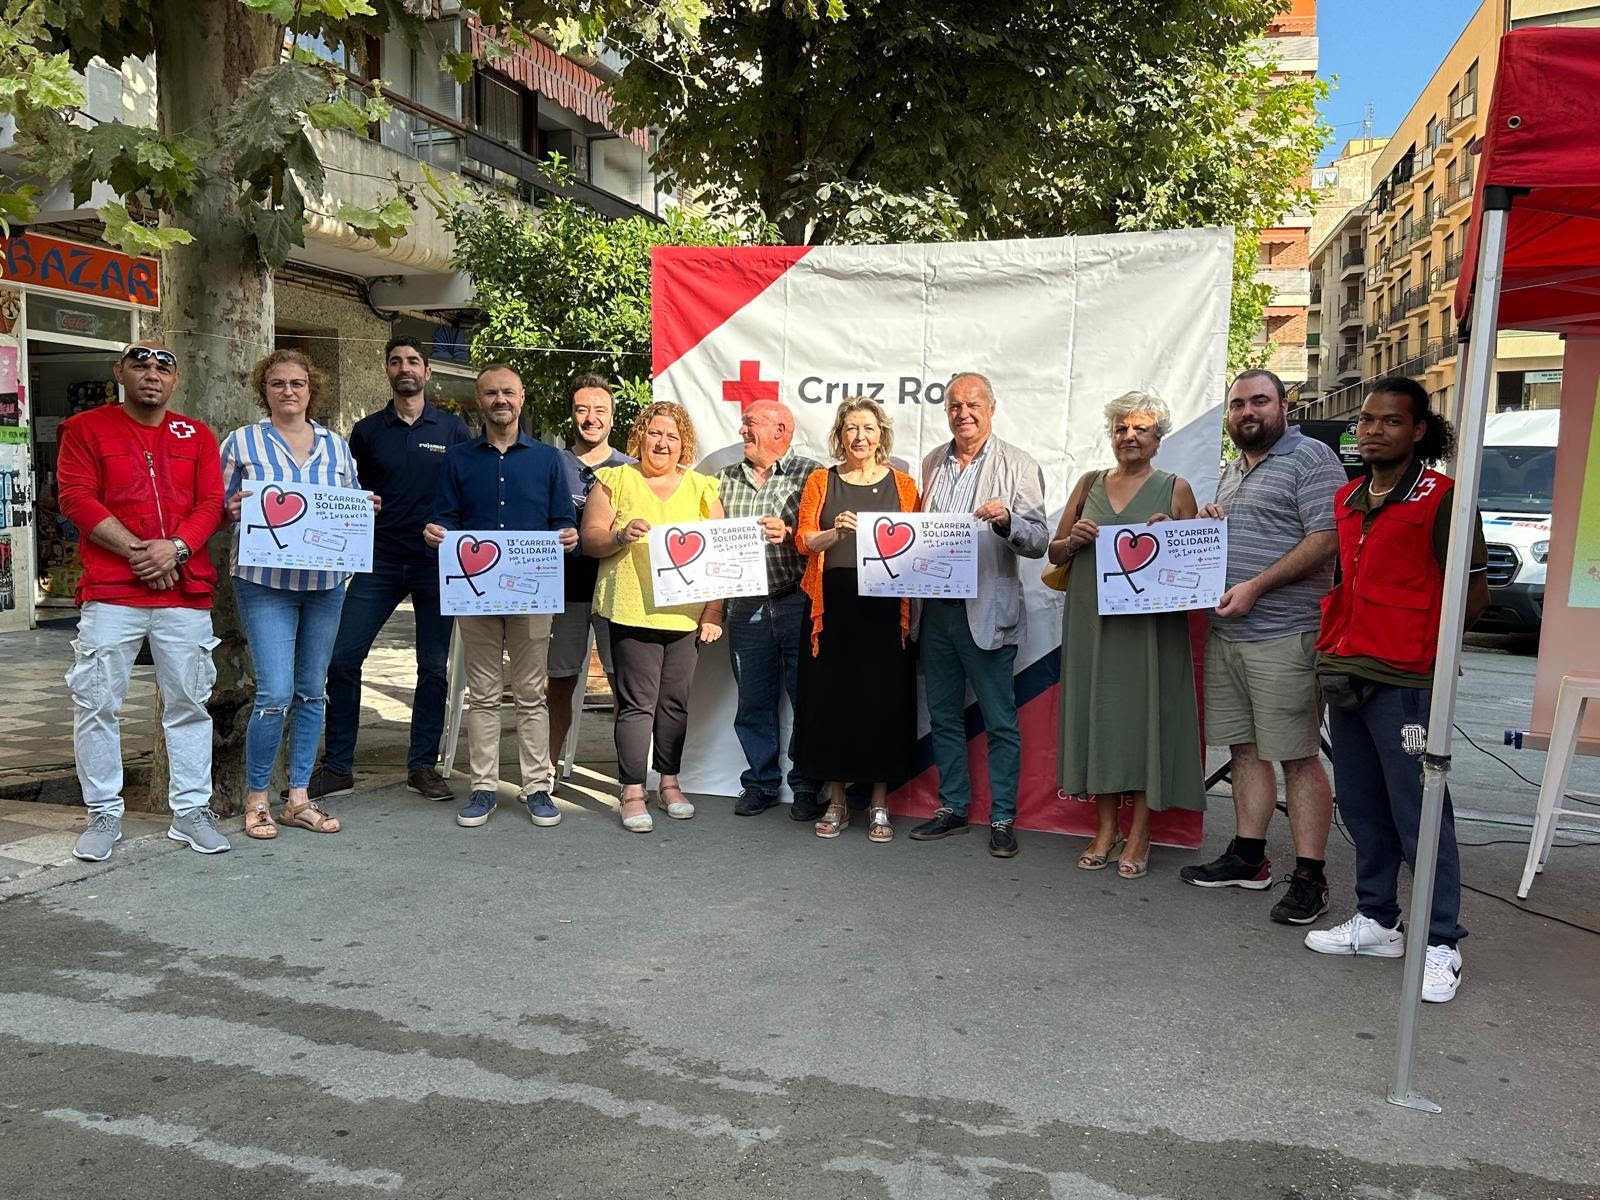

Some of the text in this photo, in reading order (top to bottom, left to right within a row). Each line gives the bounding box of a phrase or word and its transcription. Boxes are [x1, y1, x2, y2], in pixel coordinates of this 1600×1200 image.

[7, 239, 154, 300] BAZAR
[798, 376, 885, 404] Cruz
[328, 494, 367, 505] CARRERA
[315, 501, 367, 511] SOLIDARIA
[722, 525, 757, 534] CARRERA
[922, 530, 971, 538] SOLIDARIA
[1178, 527, 1220, 537] CARRERA
[712, 533, 758, 542] SOLIDARIA
[1167, 536, 1220, 547] SOLIDARIA
[519, 539, 557, 547] CARRERA
[508, 547, 557, 555] SOLIDARIA
